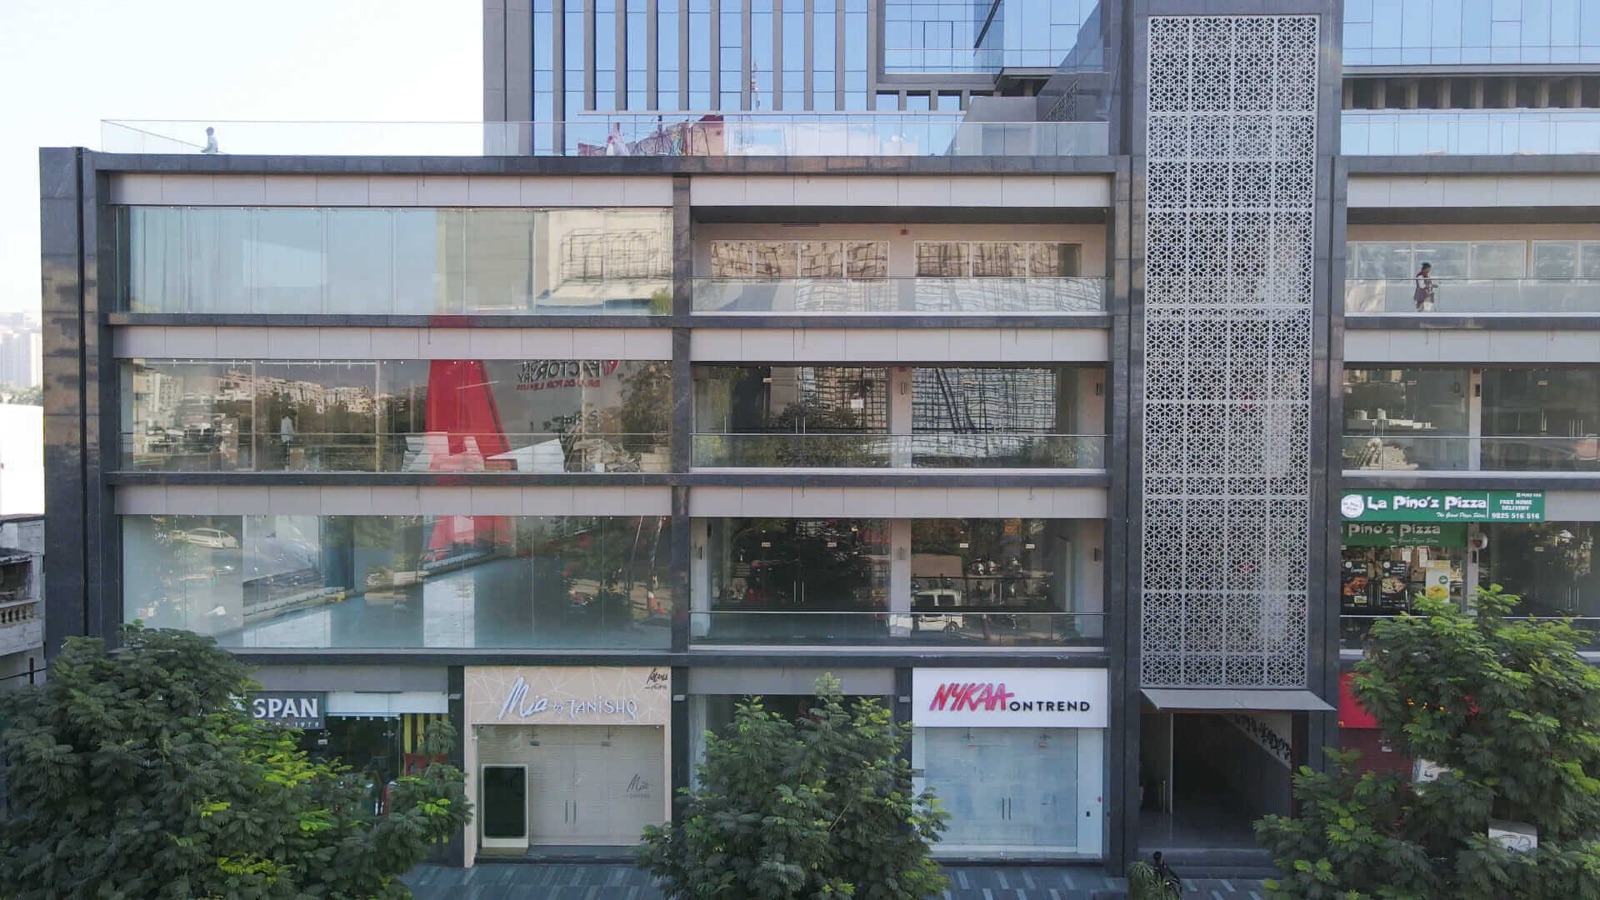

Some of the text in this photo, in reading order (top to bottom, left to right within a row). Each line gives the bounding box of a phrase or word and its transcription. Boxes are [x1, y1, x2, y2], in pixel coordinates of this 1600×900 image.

[1367, 496, 1388, 510] La
[1393, 495, 1439, 510] Pino'z
[1444, 496, 1487, 510] Pizza
[1348, 523, 1441, 537] Pino'z Pizza
[498, 676, 548, 720] Mia
[929, 683, 1015, 711] NYKAA
[253, 698, 318, 718] SPAN
